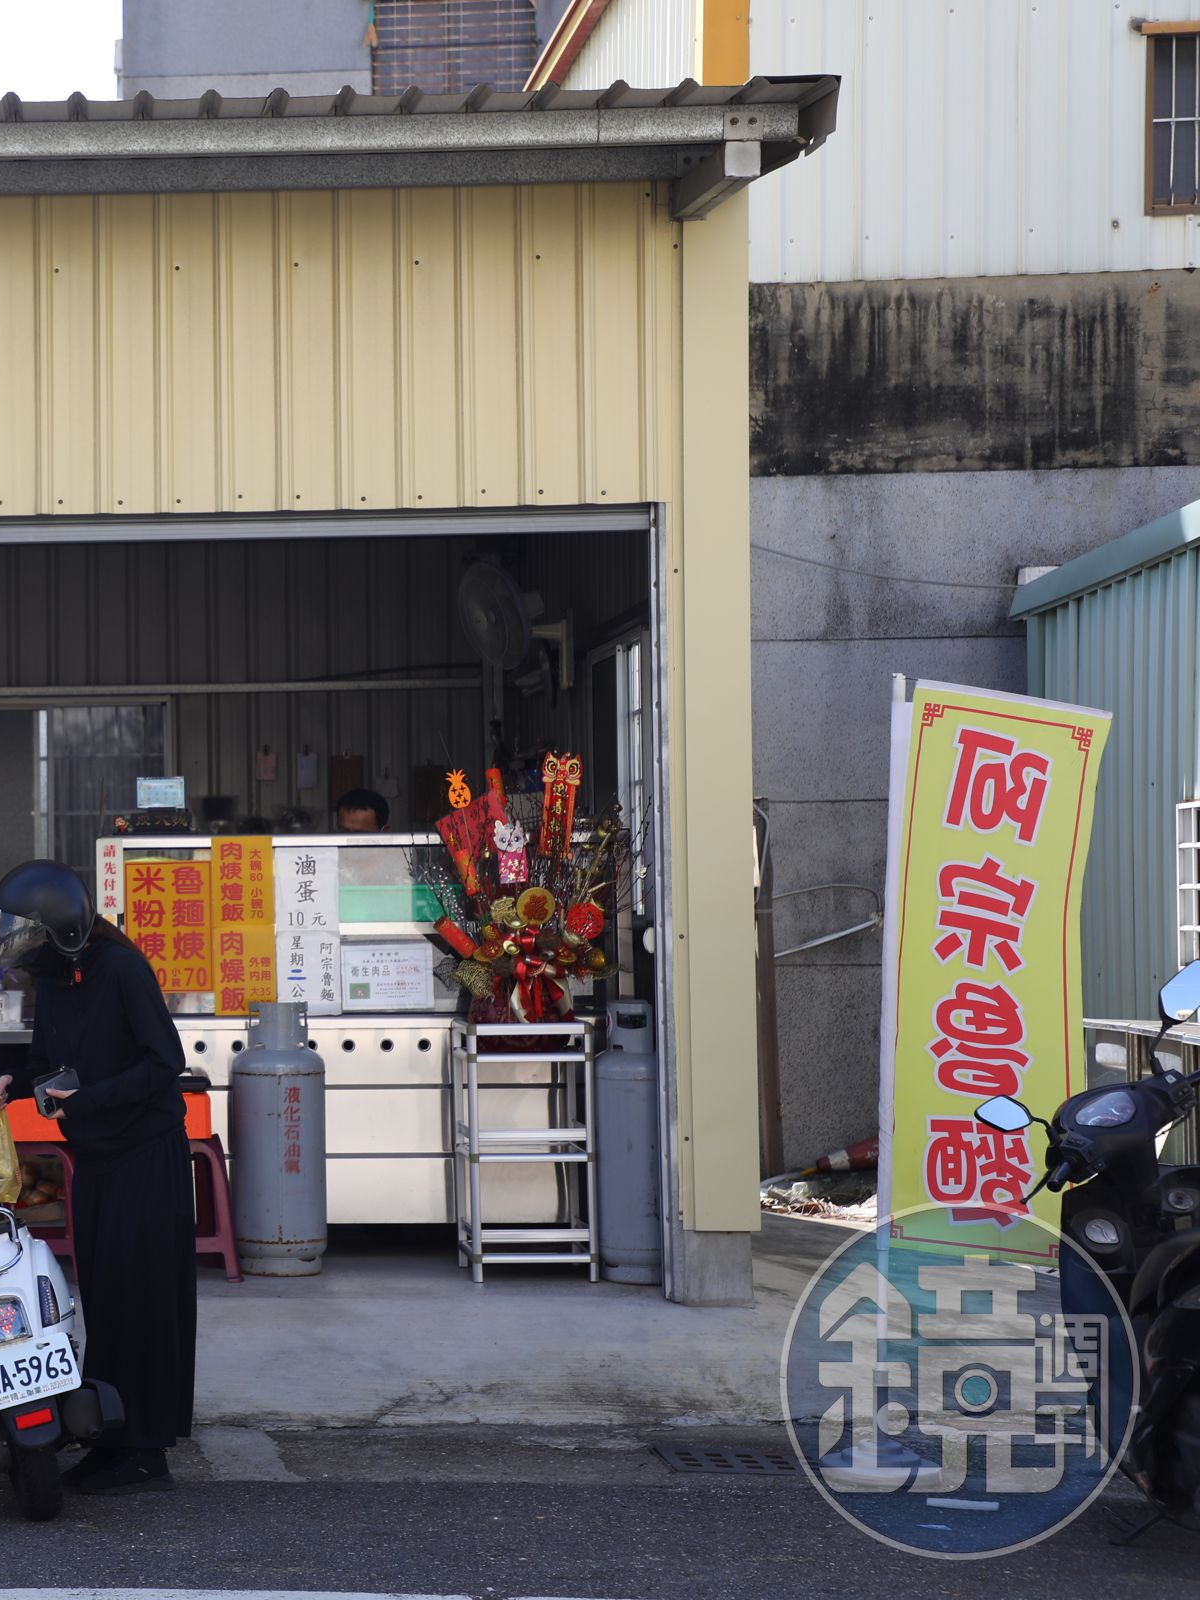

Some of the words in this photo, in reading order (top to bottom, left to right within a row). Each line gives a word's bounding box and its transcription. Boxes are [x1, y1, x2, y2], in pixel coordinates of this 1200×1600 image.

[103, 844, 117, 909] 請先付款
[294, 854, 319, 903] 滷蛋
[288, 911, 305, 927] 10
[220, 931, 246, 1012] 肉燥飯
[249, 956, 271, 968] 外帶
[287, 935, 307, 998] 星期二公
[319, 942, 336, 1002] 阿宗魯麵
[351, 964, 391, 977] 衛生肉品
[284, 1087, 301, 1175] 液化石油氣
